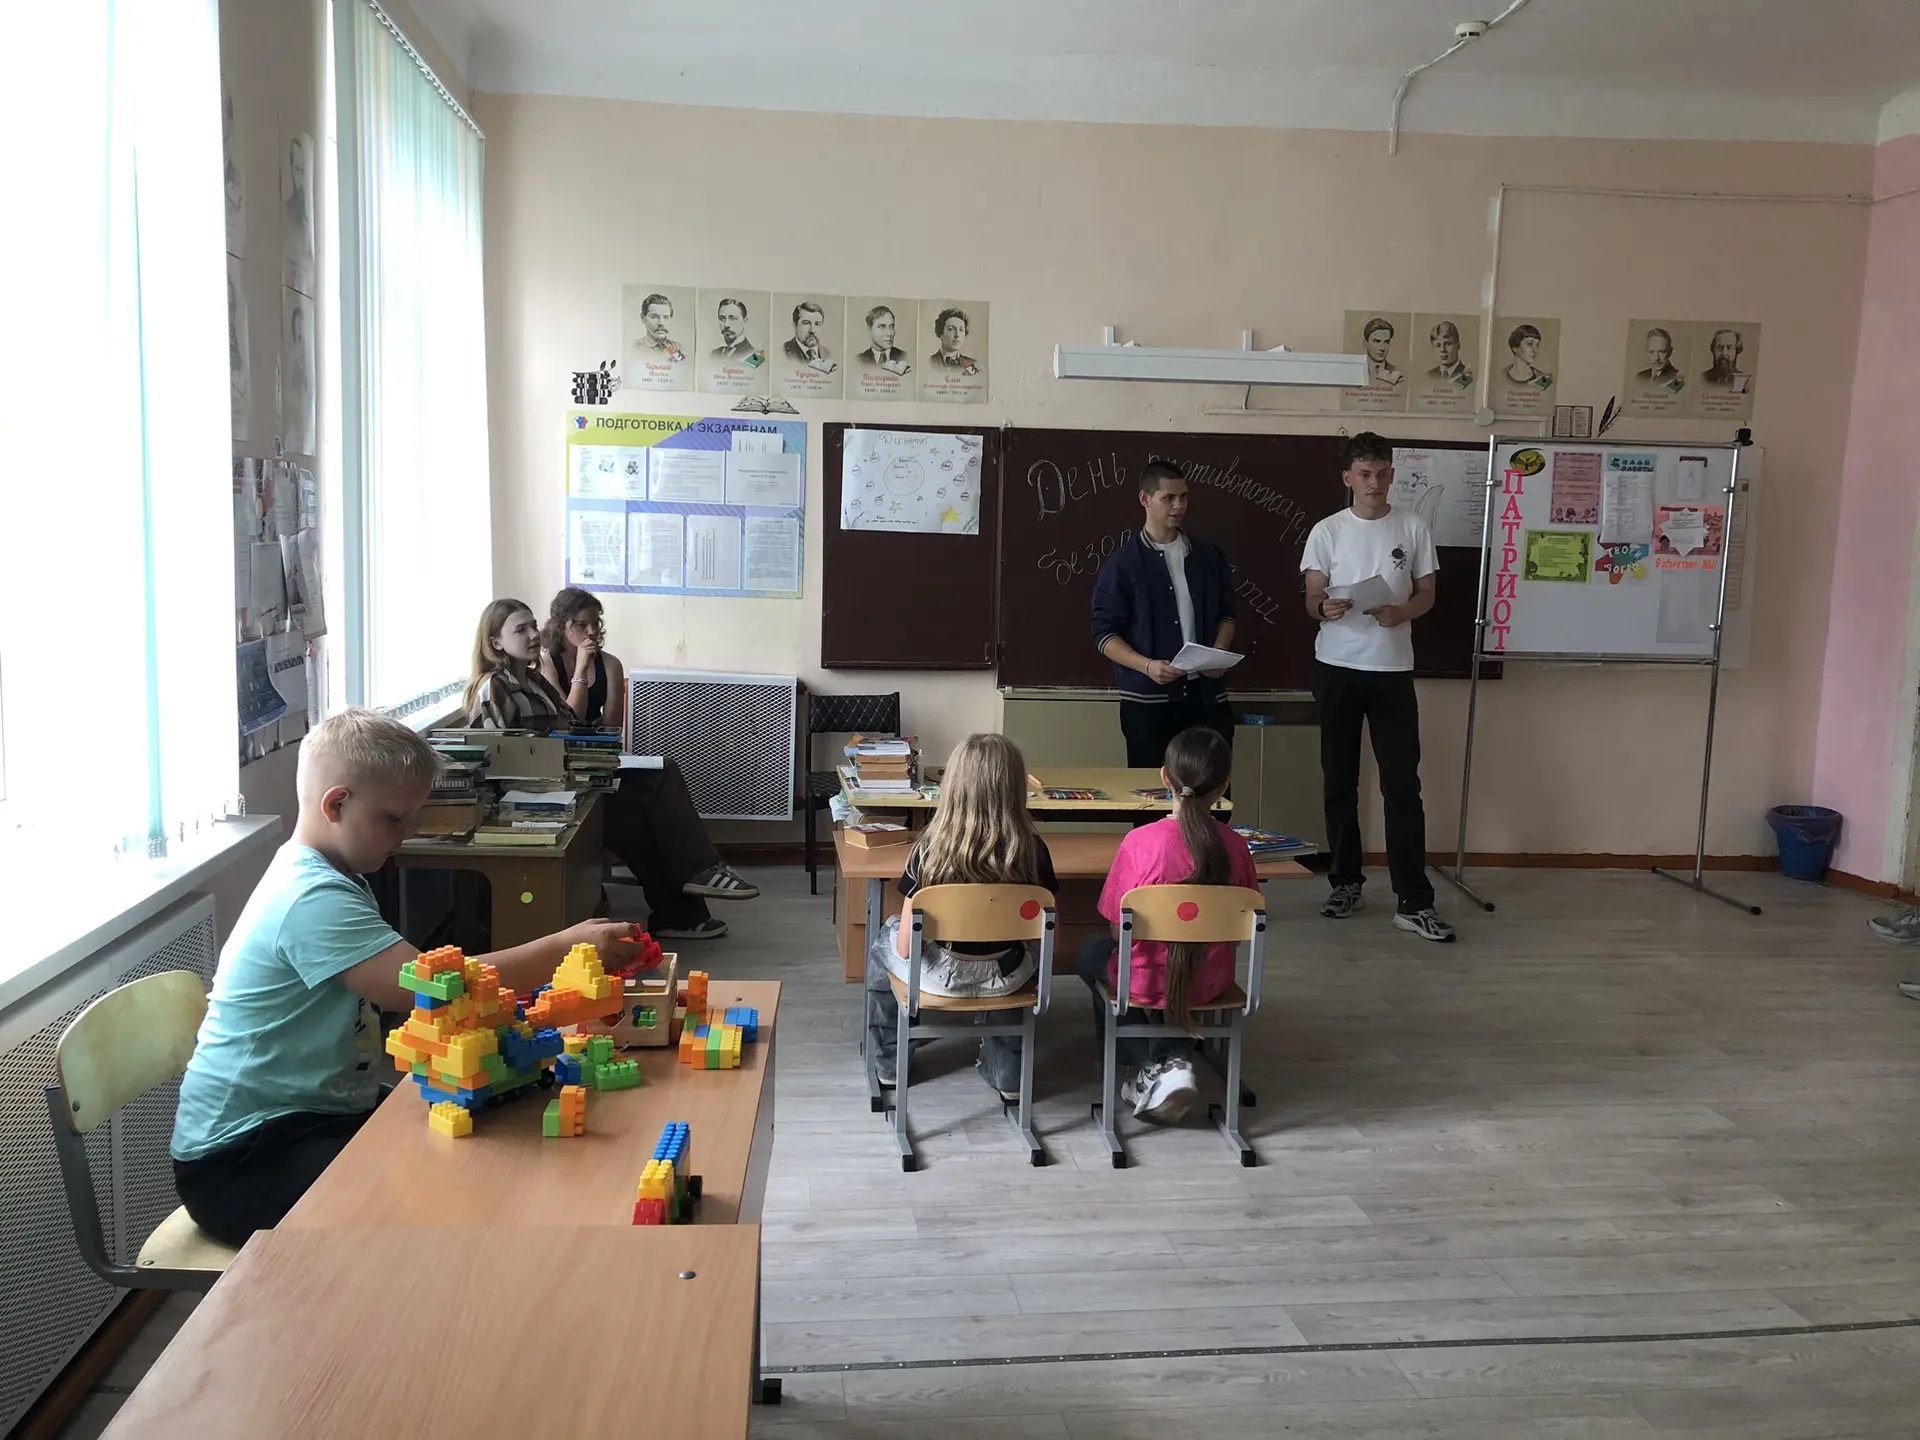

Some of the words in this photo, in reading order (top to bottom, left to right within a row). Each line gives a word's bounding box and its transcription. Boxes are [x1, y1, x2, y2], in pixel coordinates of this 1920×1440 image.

[596, 417, 683, 432] ПОДГОТОВКА
[687, 421, 695, 432] К
[698, 421, 778, 434] ЭКЗАМЕНАМ
[1027, 452, 1128, 521] День
[1492, 468, 1524, 650] ПАТРИОТ
